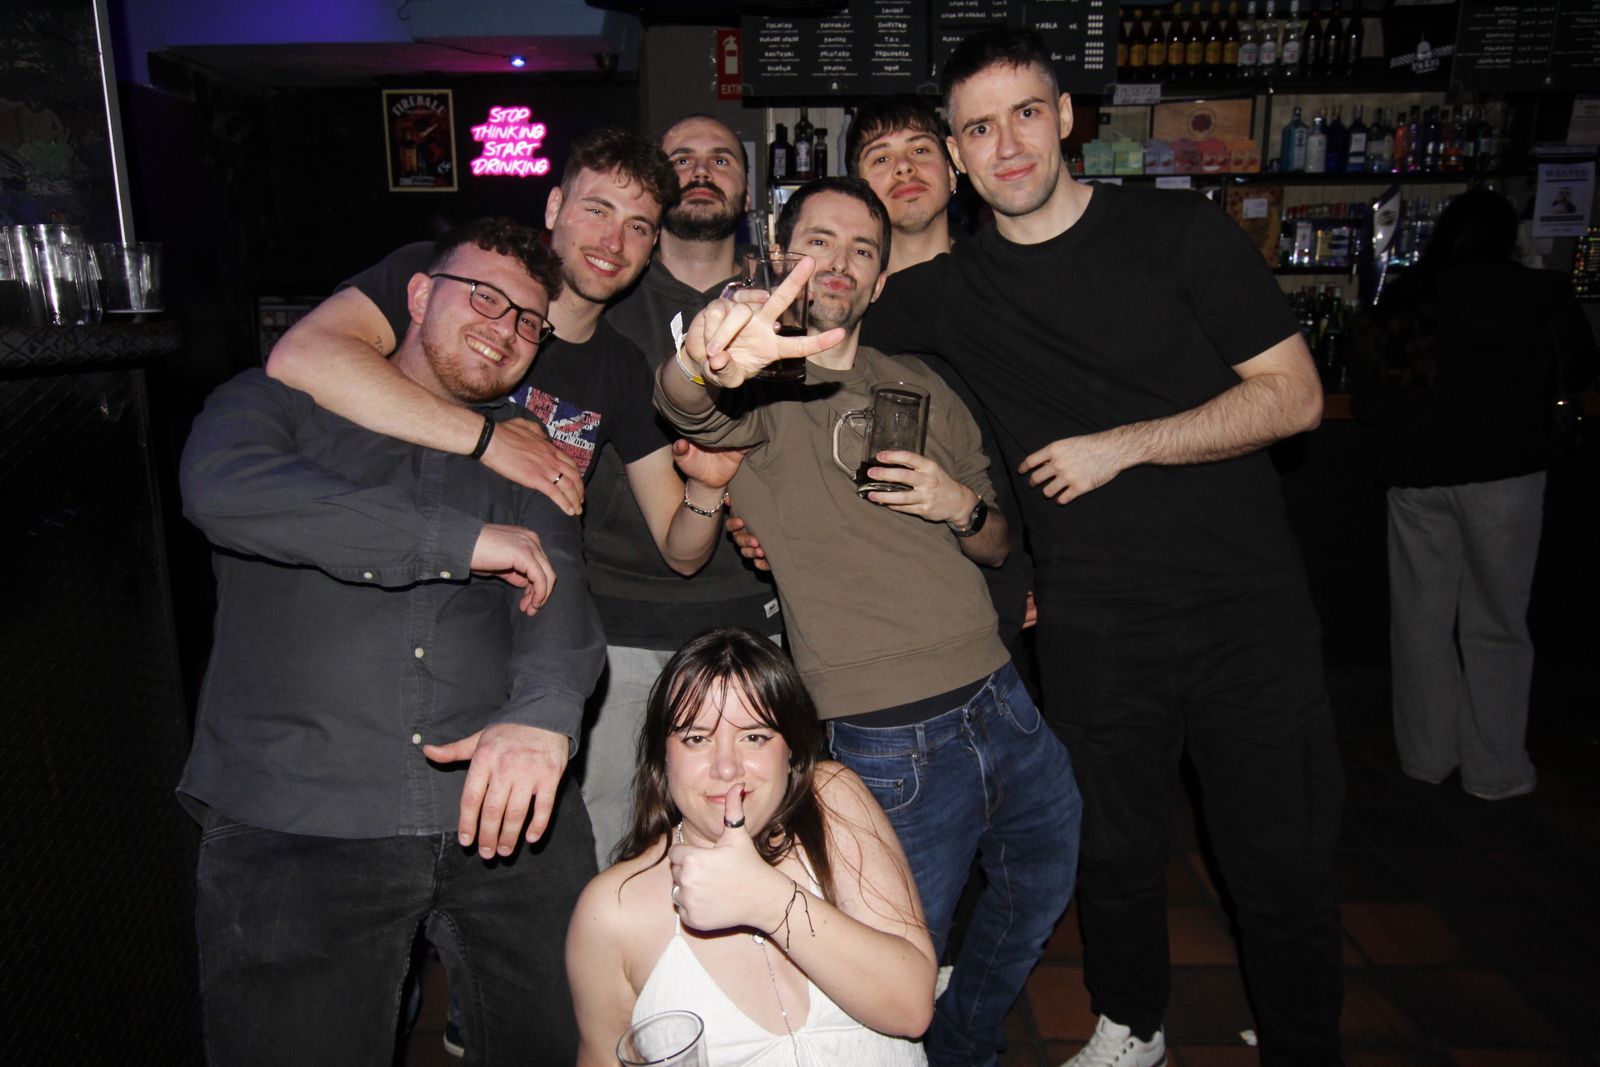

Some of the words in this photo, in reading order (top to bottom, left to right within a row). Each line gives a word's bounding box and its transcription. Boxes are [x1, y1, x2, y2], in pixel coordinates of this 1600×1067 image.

[391, 95, 445, 117] FIREBALL
[488, 106, 530, 124] STOP
[471, 123, 546, 142] THINKING
[483, 140, 541, 159] START
[470, 157, 550, 177] DRINKING
